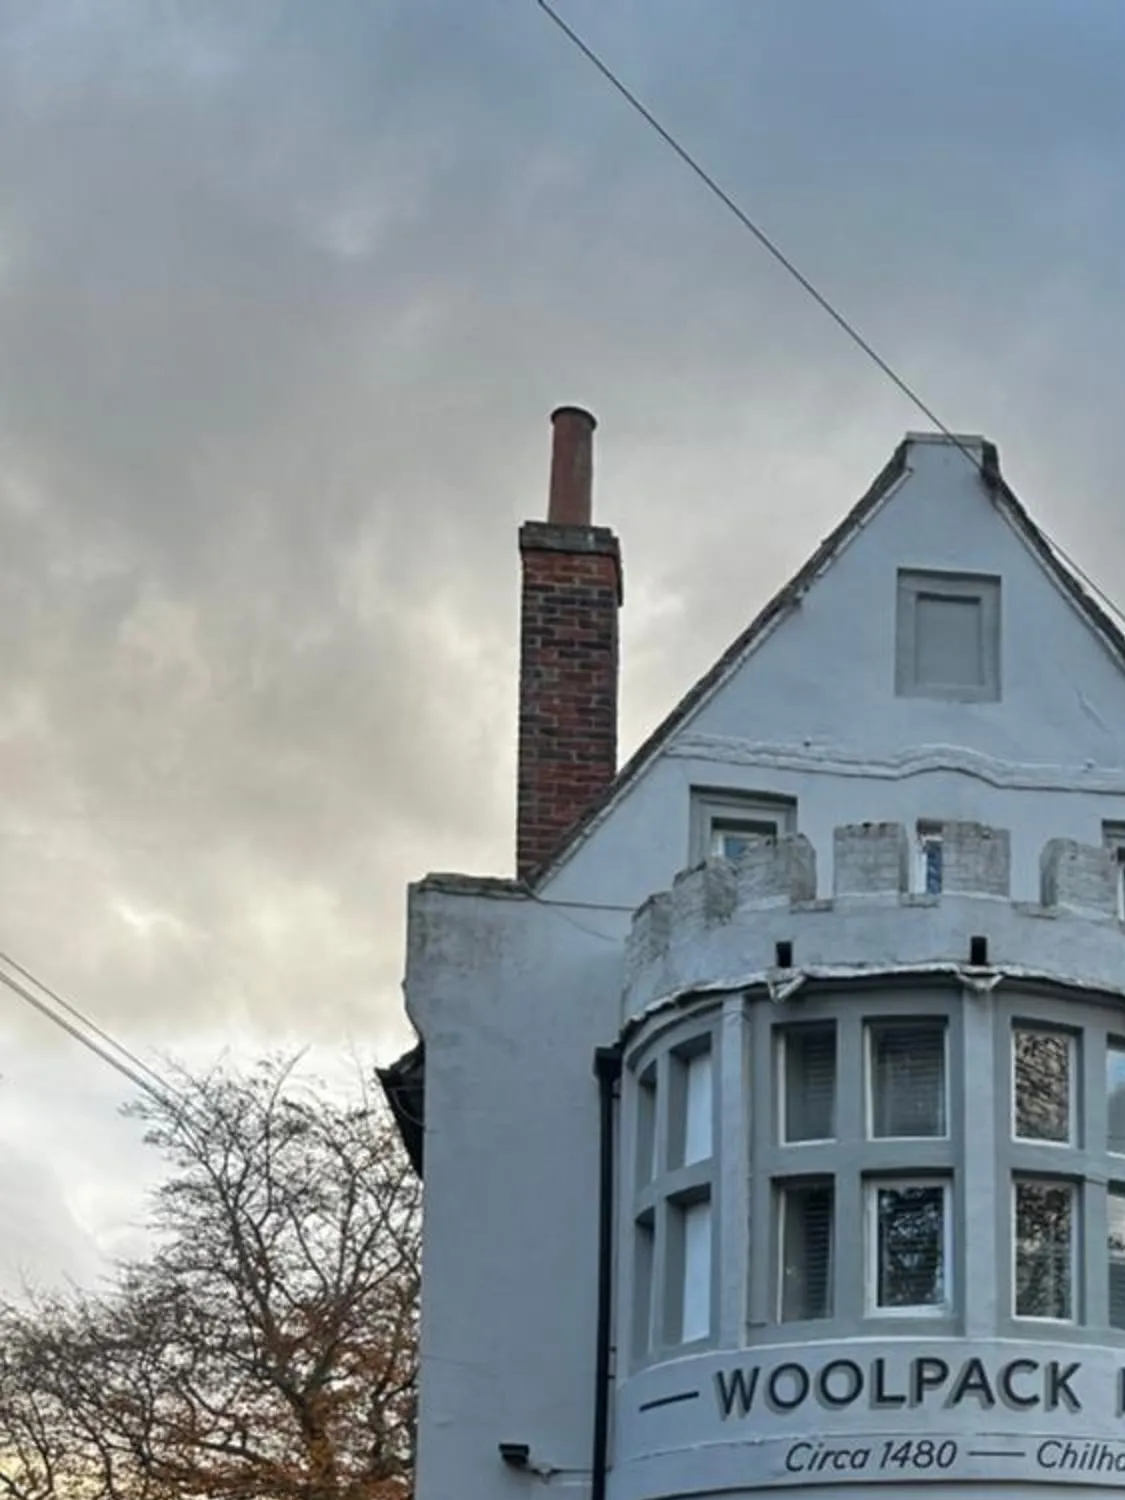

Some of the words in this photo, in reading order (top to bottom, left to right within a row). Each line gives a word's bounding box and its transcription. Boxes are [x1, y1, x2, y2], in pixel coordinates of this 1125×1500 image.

[714, 1357, 1082, 1421] WOOLPACK
[785, 1441, 870, 1472] Circa
[879, 1439, 958, 1470] 1480
